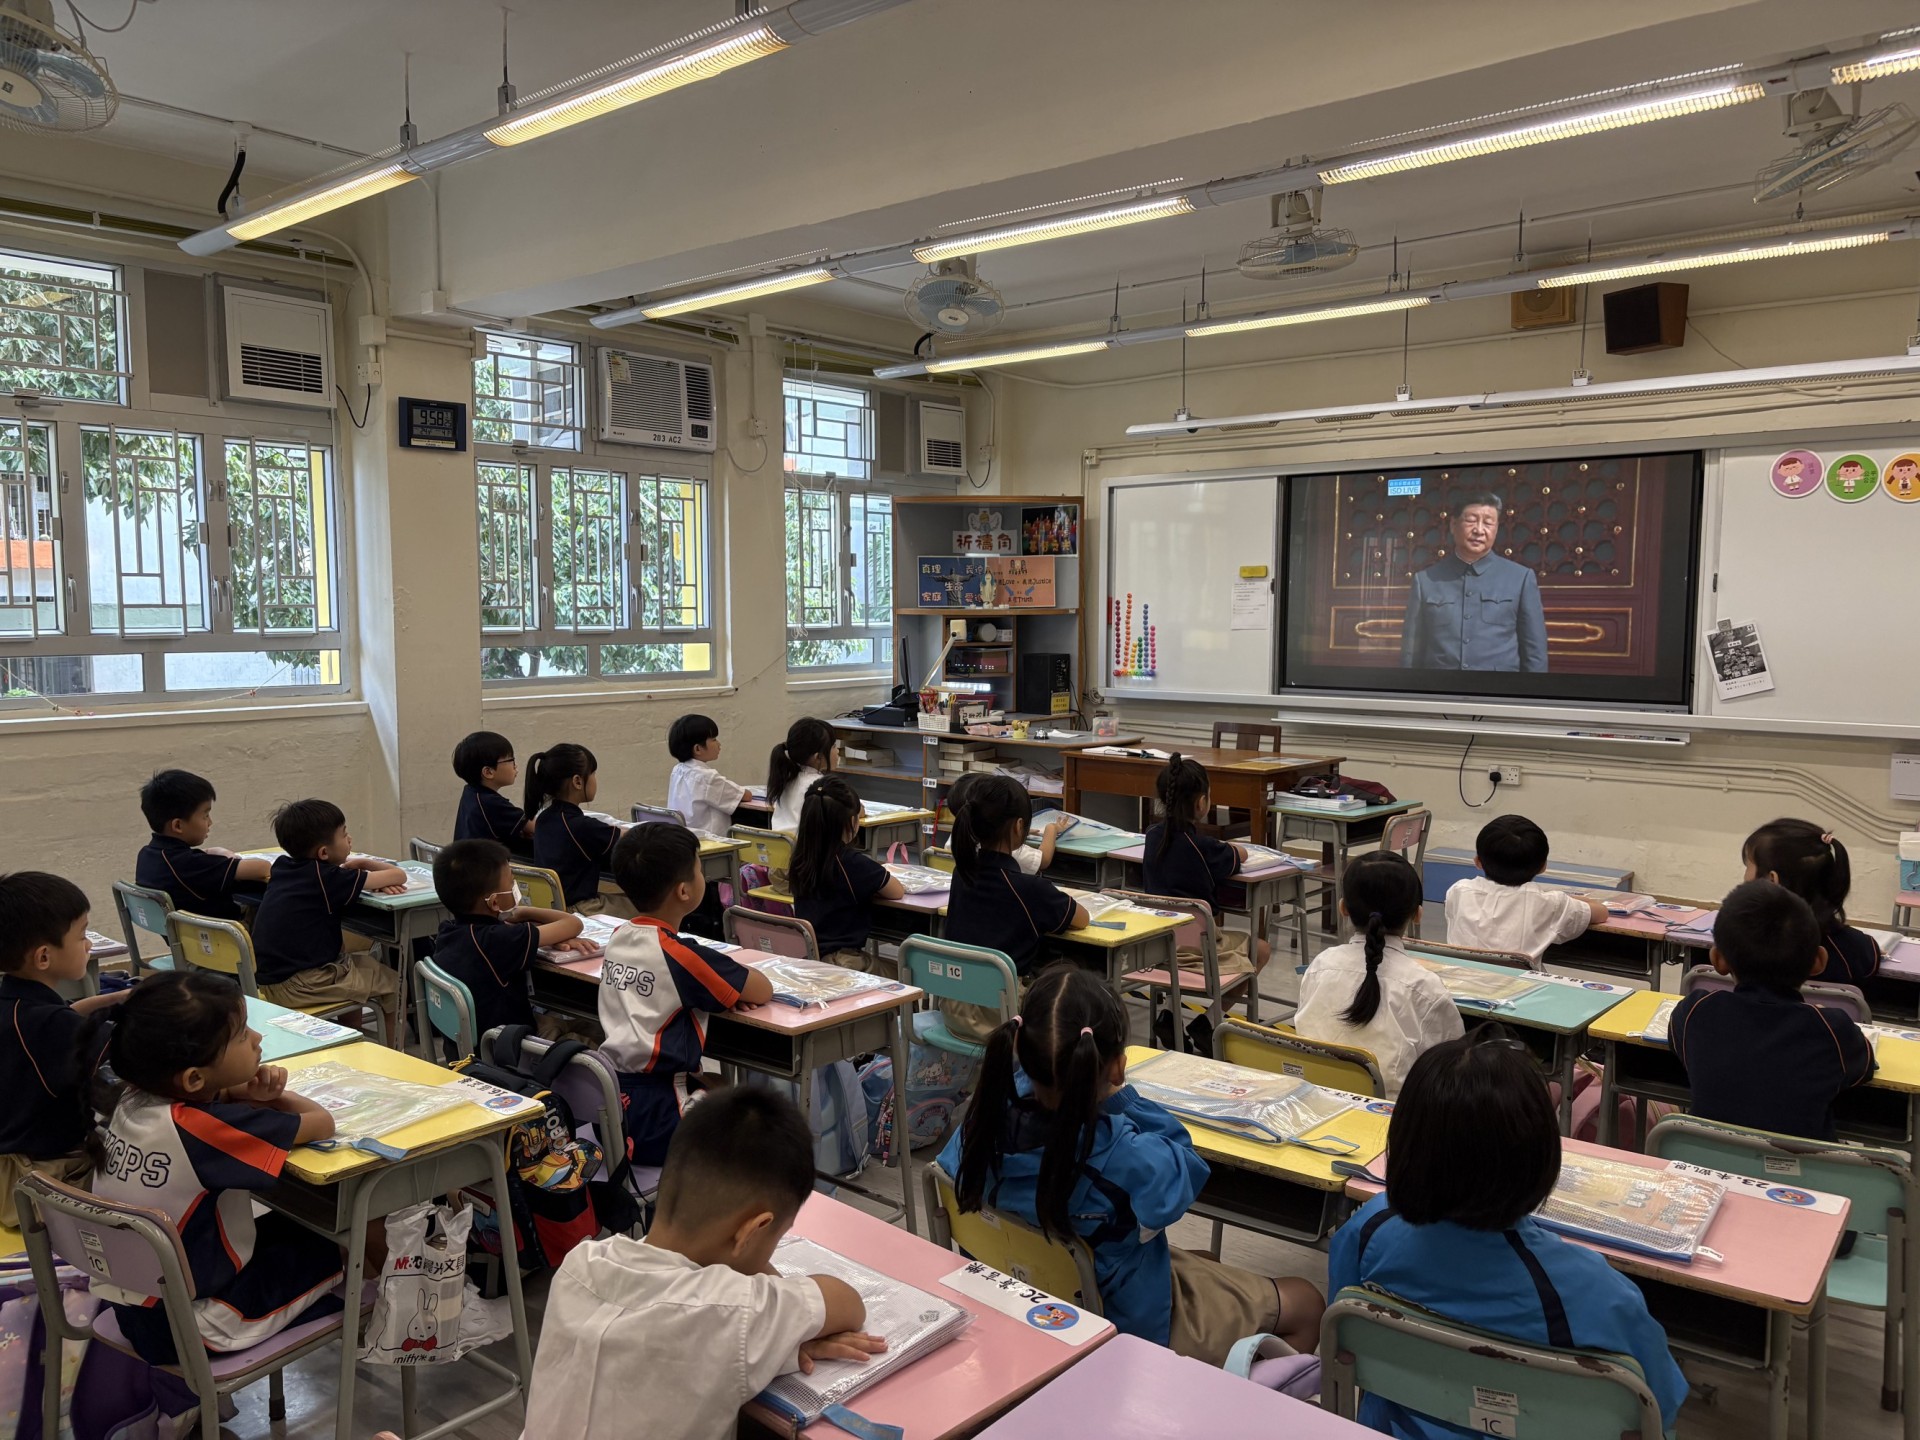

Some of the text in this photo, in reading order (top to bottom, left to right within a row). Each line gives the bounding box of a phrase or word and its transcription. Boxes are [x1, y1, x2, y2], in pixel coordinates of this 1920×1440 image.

[653, 433, 682, 444] 203 AC2
[1403, 486, 1419, 494] LIVE
[956, 533, 1012, 551] 祈禱角
[922, 564, 942, 574] 真理
[944, 581, 964, 592] 生命
[921, 592, 942, 602] 家庭
[949, 967, 961, 977] 1C
[1736, 1176, 1771, 1189] 23.
[89, 1255, 104, 1272] 1C
[393, 1353, 420, 1365] miffy
[1481, 1417, 1503, 1435] 1C
